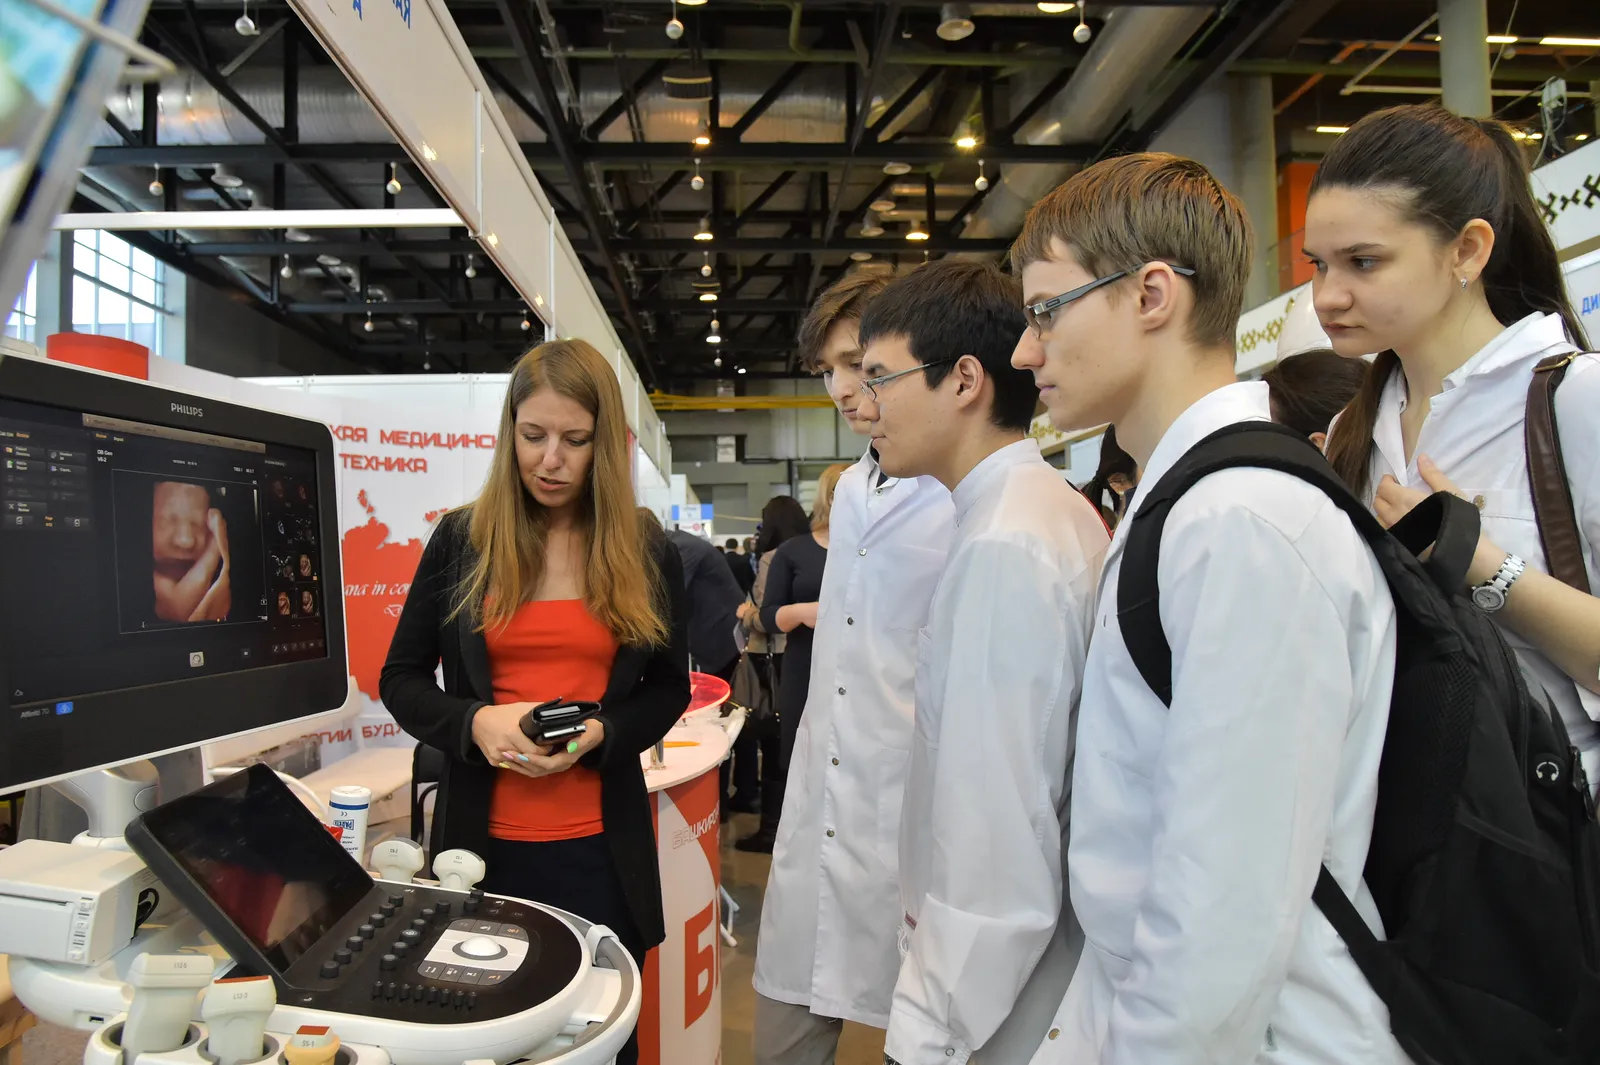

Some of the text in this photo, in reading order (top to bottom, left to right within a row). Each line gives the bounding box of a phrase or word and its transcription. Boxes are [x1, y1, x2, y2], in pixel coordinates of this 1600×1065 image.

[1581, 293, 1600, 316] ДИ
[170, 402, 204, 417] PHILIPS
[339, 453, 427, 473] ТЕХНИКА
[372, 580, 387, 596] in
